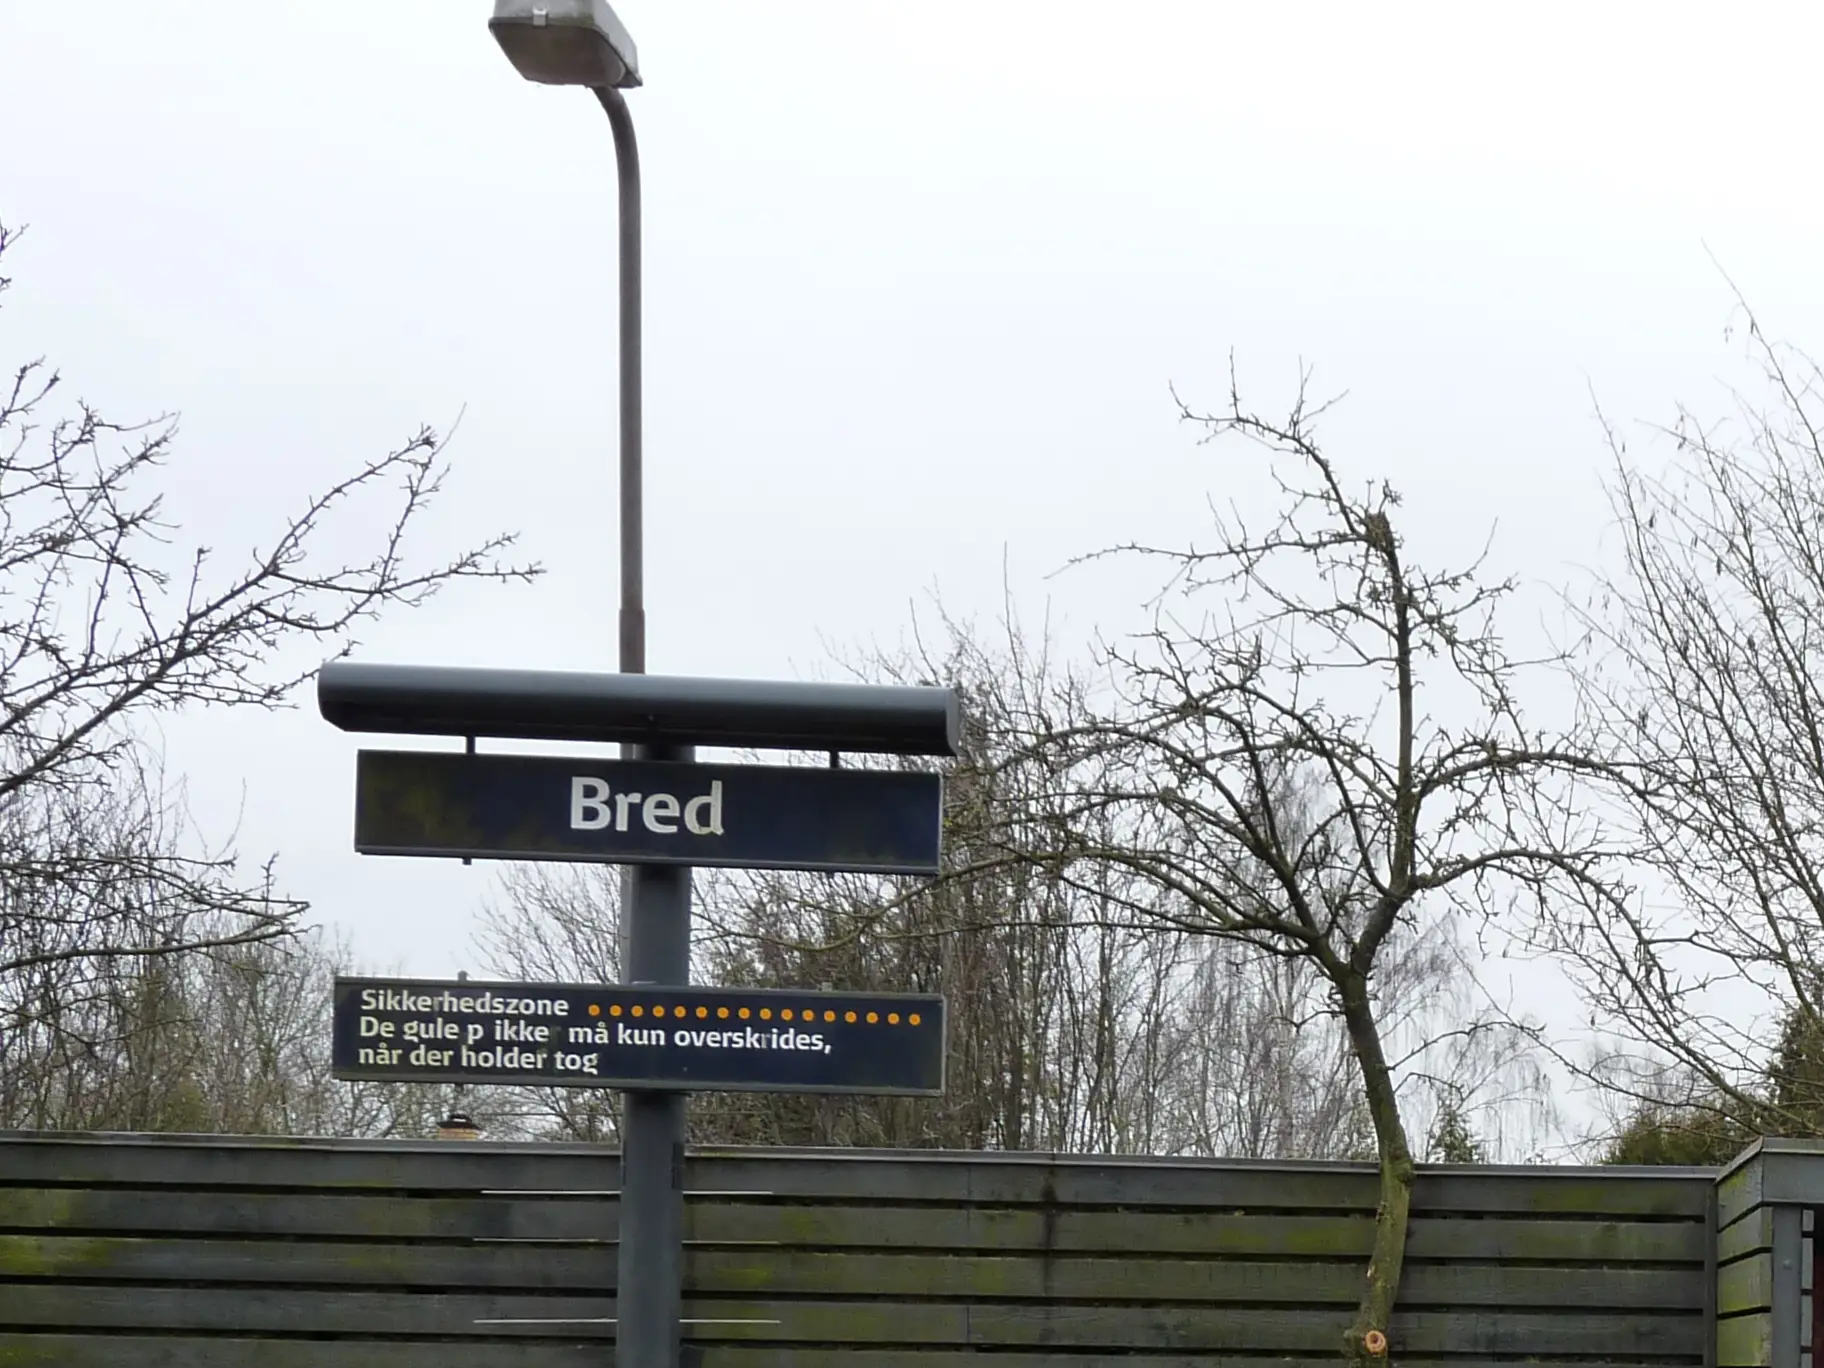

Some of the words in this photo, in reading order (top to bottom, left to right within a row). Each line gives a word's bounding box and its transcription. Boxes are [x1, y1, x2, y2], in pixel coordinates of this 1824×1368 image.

[570, 776, 725, 836] Bred
[361, 988, 570, 1017] Sikkerhedszone
[359, 1015, 396, 1038] De
[402, 1017, 460, 1043] gule
[568, 1021, 609, 1044] må
[617, 1023, 666, 1047] kun
[673, 1026, 832, 1054] overskrides,
[358, 1042, 403, 1066] når
[409, 1044, 454, 1067] der
[460, 1044, 548, 1069] holder
[553, 1050, 600, 1075] tog
